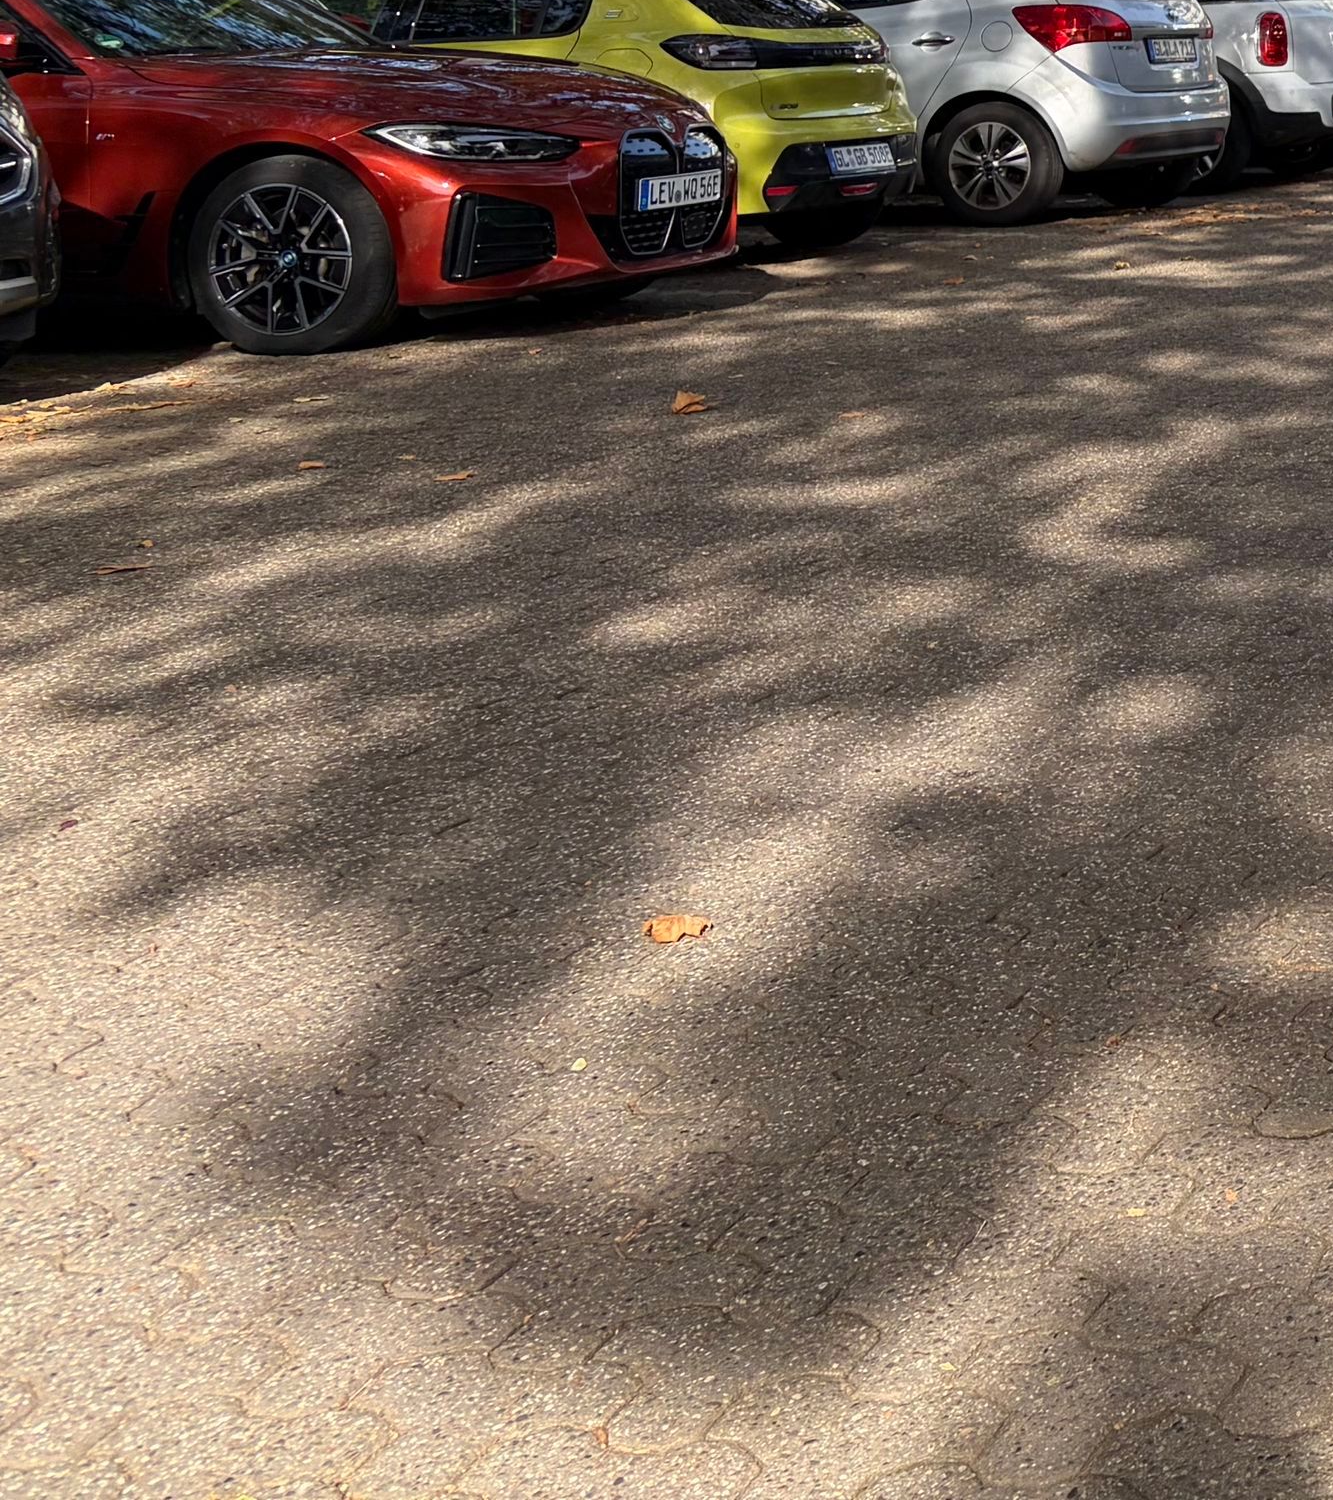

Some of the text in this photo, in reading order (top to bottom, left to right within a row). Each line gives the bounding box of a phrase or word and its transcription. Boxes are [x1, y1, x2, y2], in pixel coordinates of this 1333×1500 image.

[833, 149, 850, 168] GL
[867, 145, 893, 165] 508E
[650, 181, 676, 205] LEV
[700, 175, 719, 198] 56E
